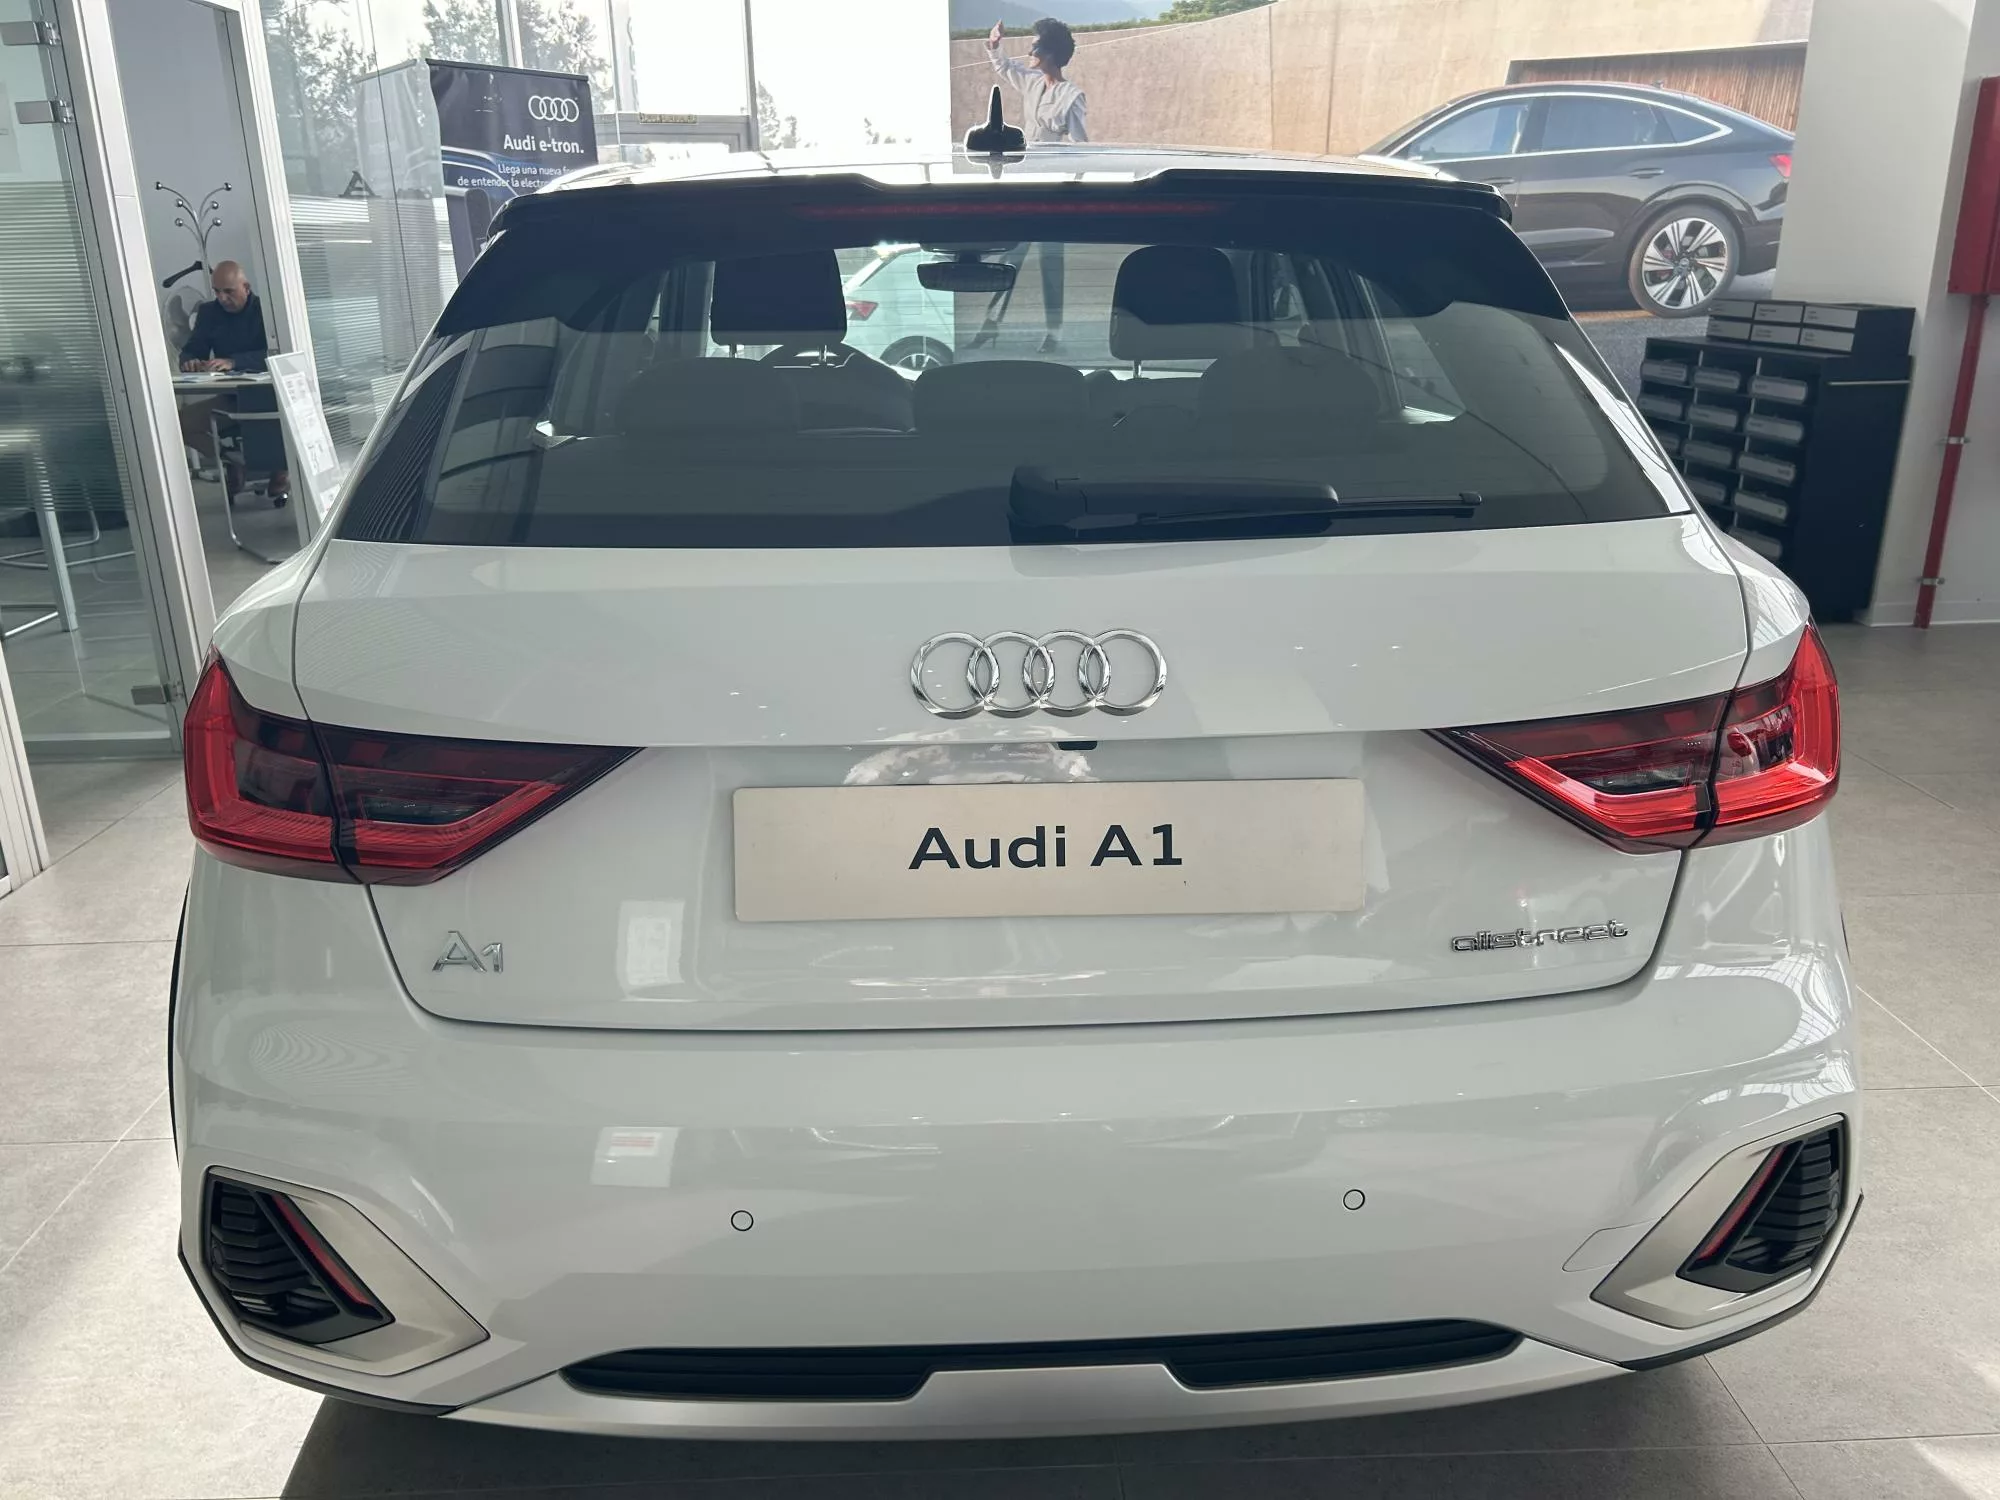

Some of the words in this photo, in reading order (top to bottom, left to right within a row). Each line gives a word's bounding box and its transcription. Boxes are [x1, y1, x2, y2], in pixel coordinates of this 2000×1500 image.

[503, 134, 536, 151] Audi
[539, 137, 585, 154] e-tron.
[457, 176, 469, 187] de
[471, 177, 510, 187] entender
[511, 178, 520, 188] la
[498, 164, 520, 176] Llega
[521, 167, 538, 175] una
[539, 167, 561, 176] nueva
[908, 825, 1066, 870] Audi
[1089, 823, 1183, 867] A1
[1452, 919, 1629, 952] allstreet
[432, 930, 504, 973] A1
